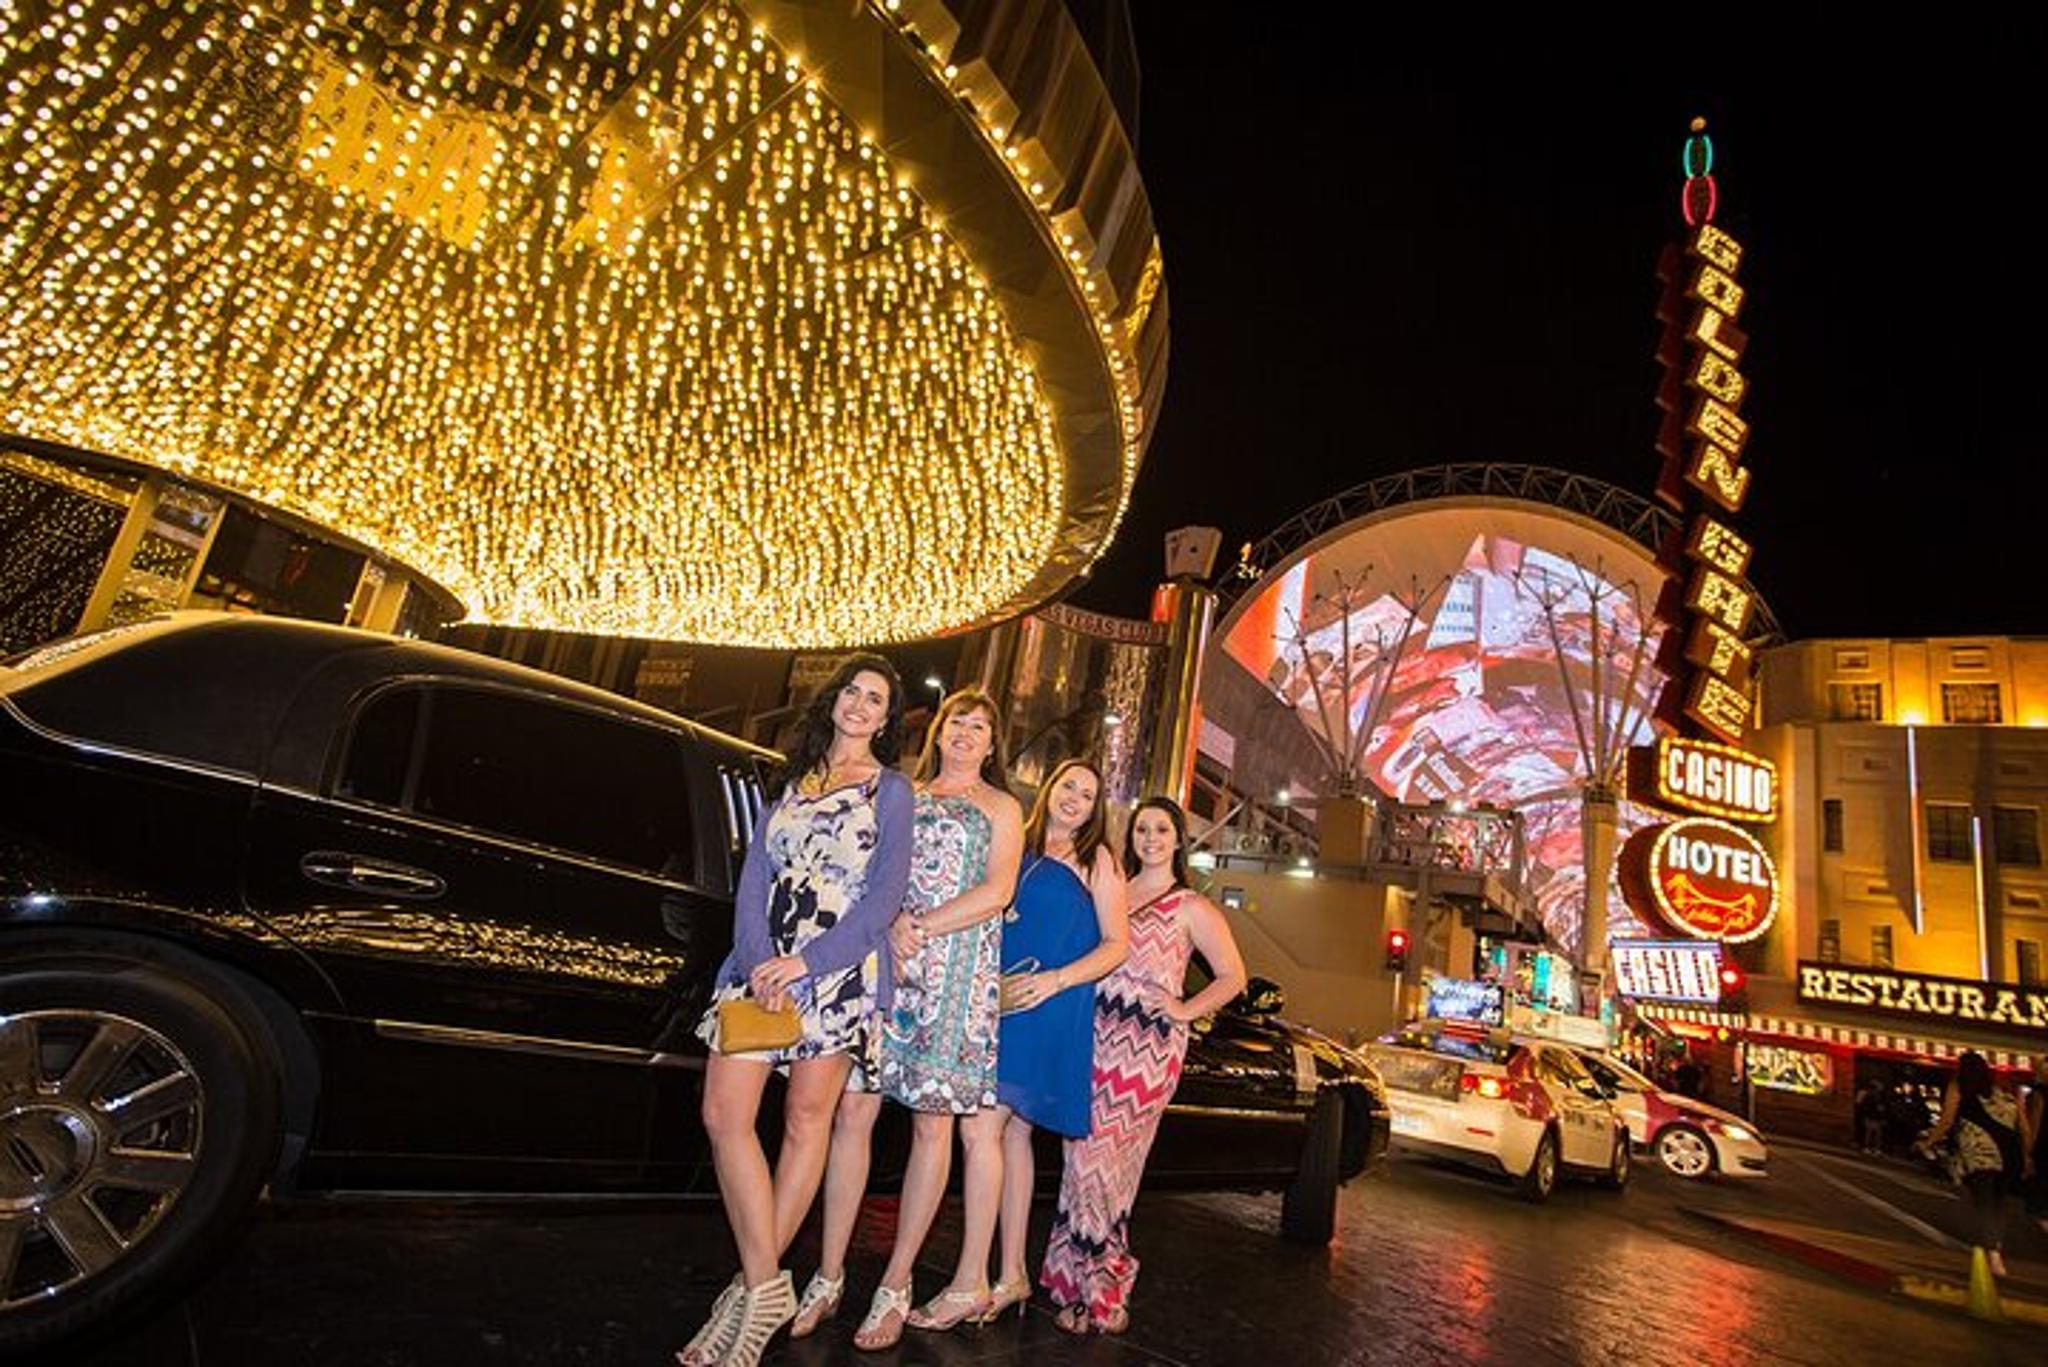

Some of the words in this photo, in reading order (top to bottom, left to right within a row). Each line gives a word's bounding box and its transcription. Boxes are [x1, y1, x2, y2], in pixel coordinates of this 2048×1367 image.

[1696, 224, 1748, 502] GOLDEN
[1698, 519, 1750, 738] GATE
[1668, 748, 1771, 813] CASINO
[1668, 836, 1769, 887] HOTEL
[1611, 947, 1720, 1000] CASINO
